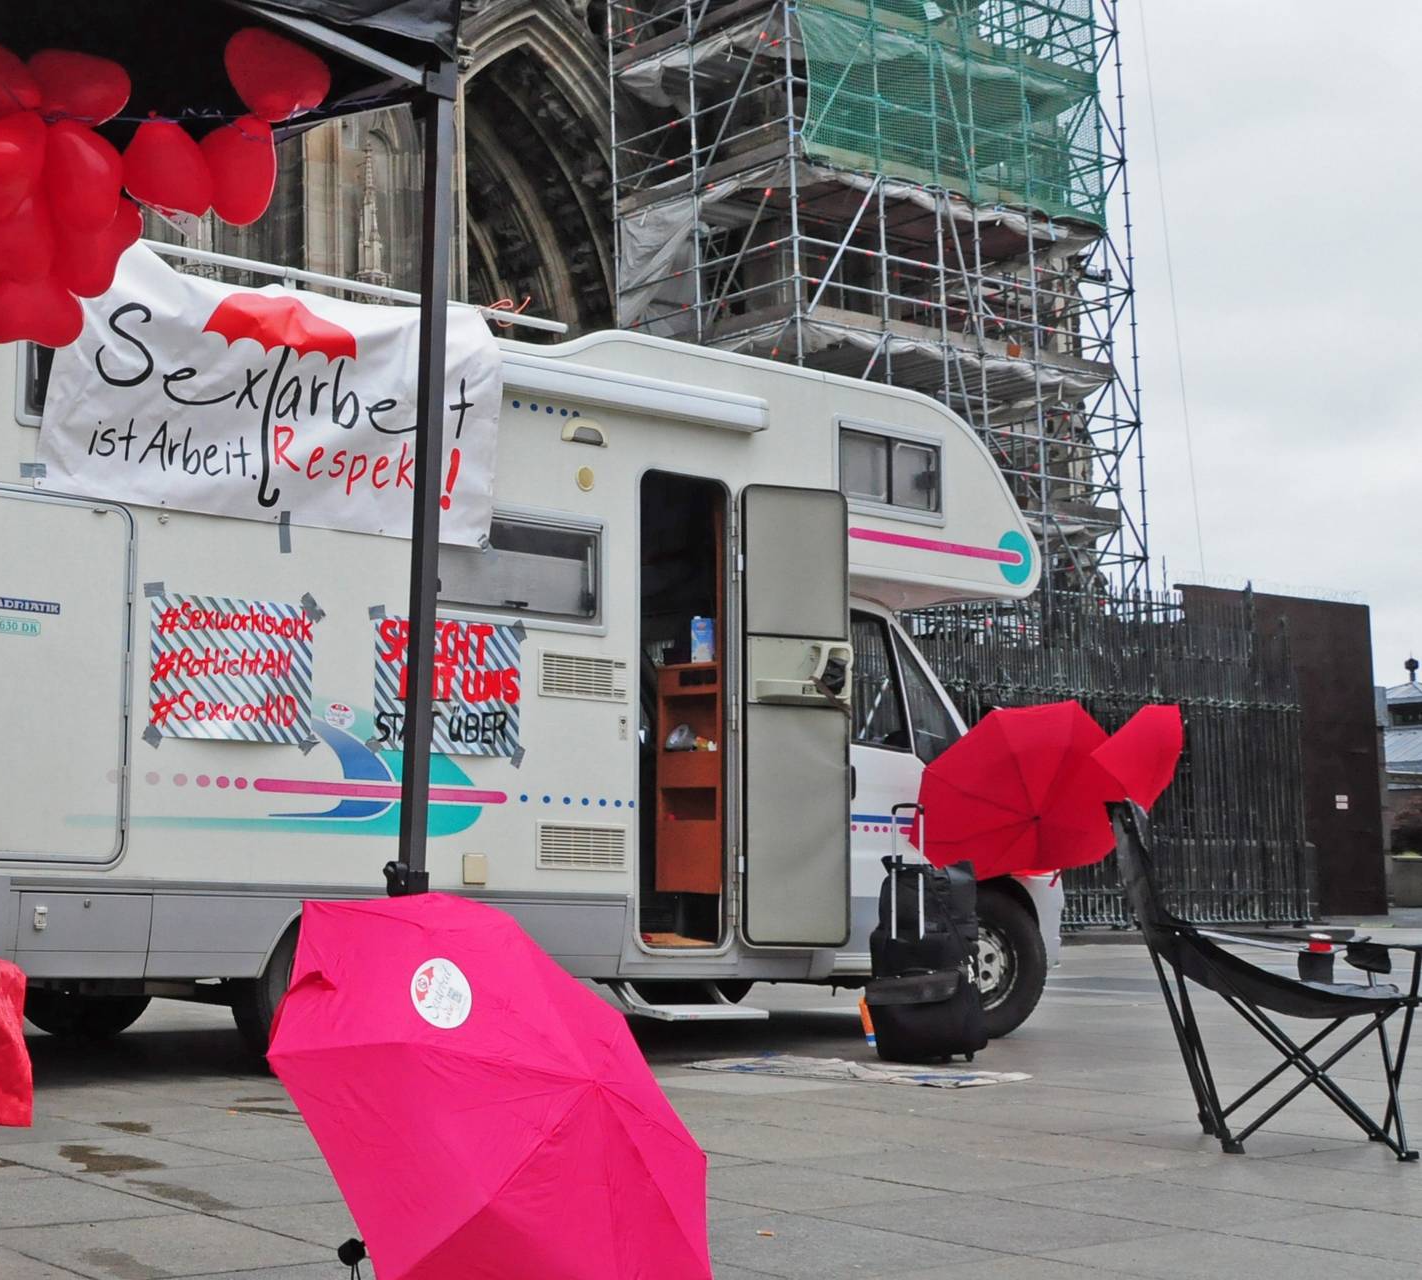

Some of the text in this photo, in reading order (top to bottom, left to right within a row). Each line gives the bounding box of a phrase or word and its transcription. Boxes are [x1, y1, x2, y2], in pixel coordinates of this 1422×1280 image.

[95, 302, 475, 440] Sexarbet
[88, 418, 462, 510] ist Arbeit. Respek!
[462, 665, 520, 704] UNS
[448, 705, 508, 744] ÜBER
